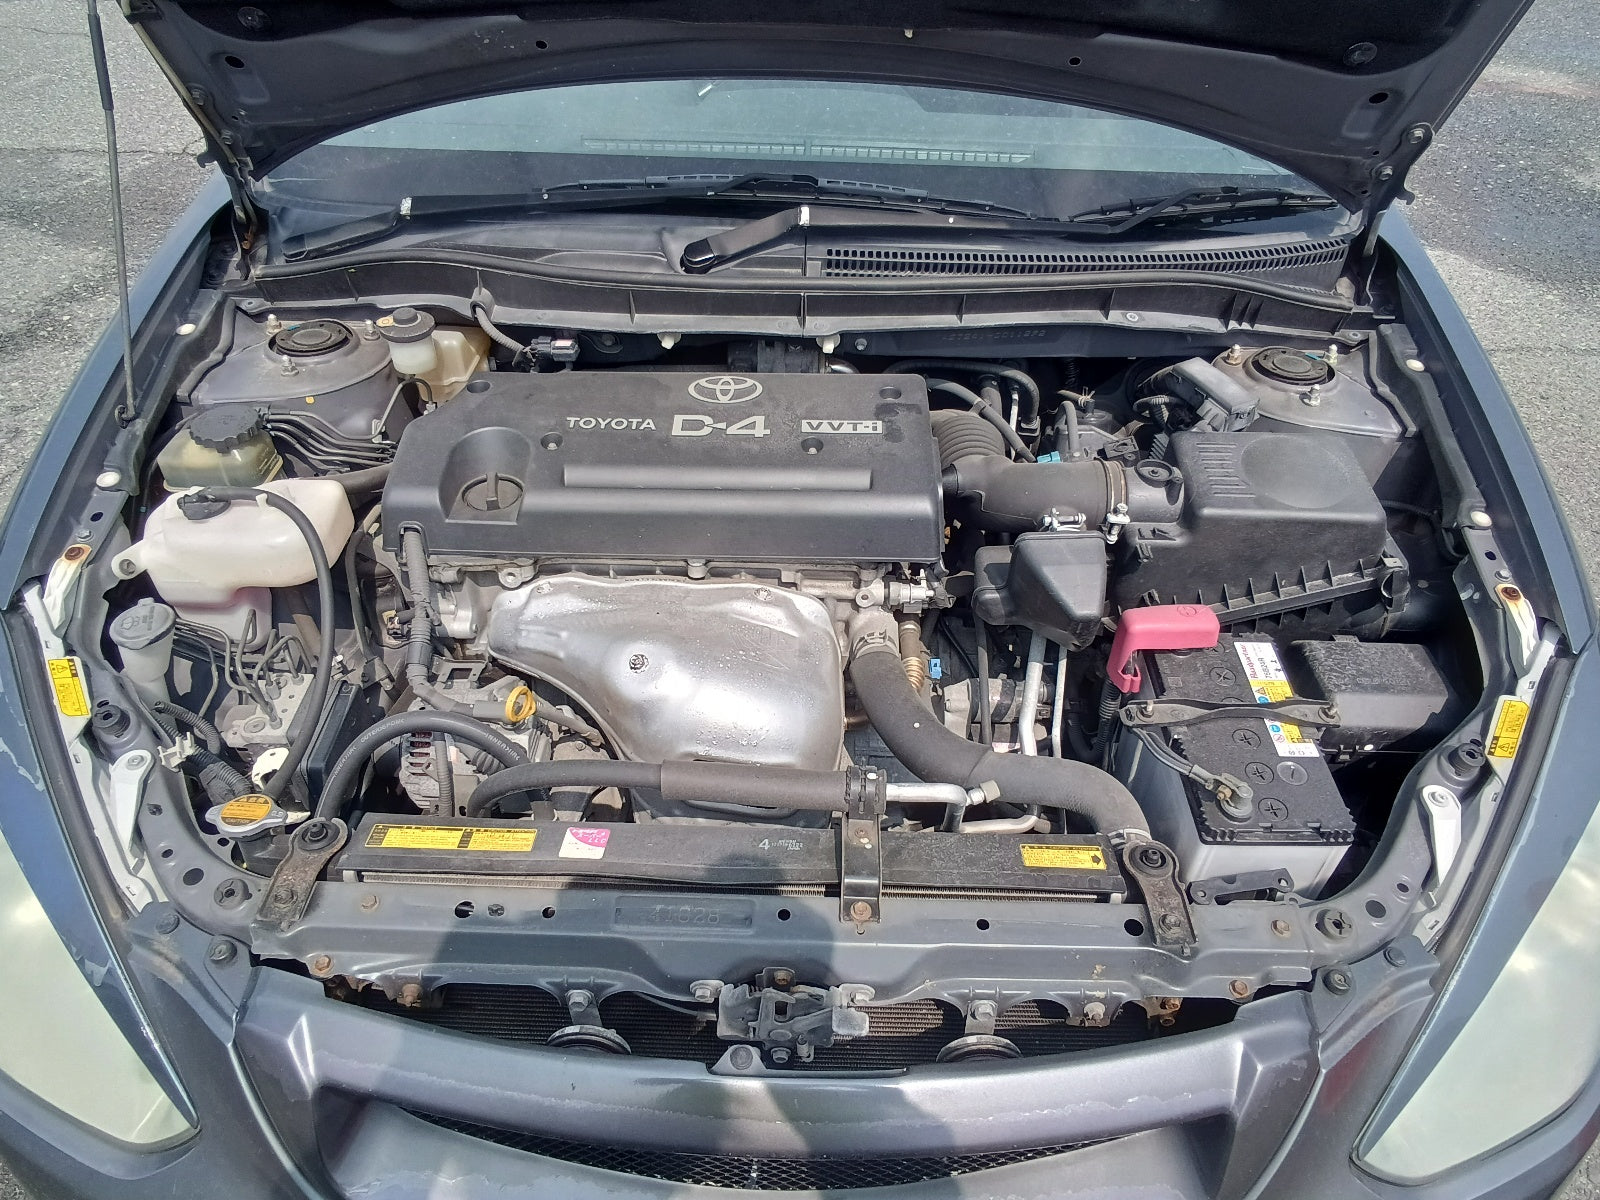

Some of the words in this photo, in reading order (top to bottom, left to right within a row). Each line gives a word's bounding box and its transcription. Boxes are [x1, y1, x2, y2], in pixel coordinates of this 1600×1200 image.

[566, 416, 657, 431] TOYOTA
[671, 414, 771, 438] D-4
[804, 420, 879, 433] VVT-i
